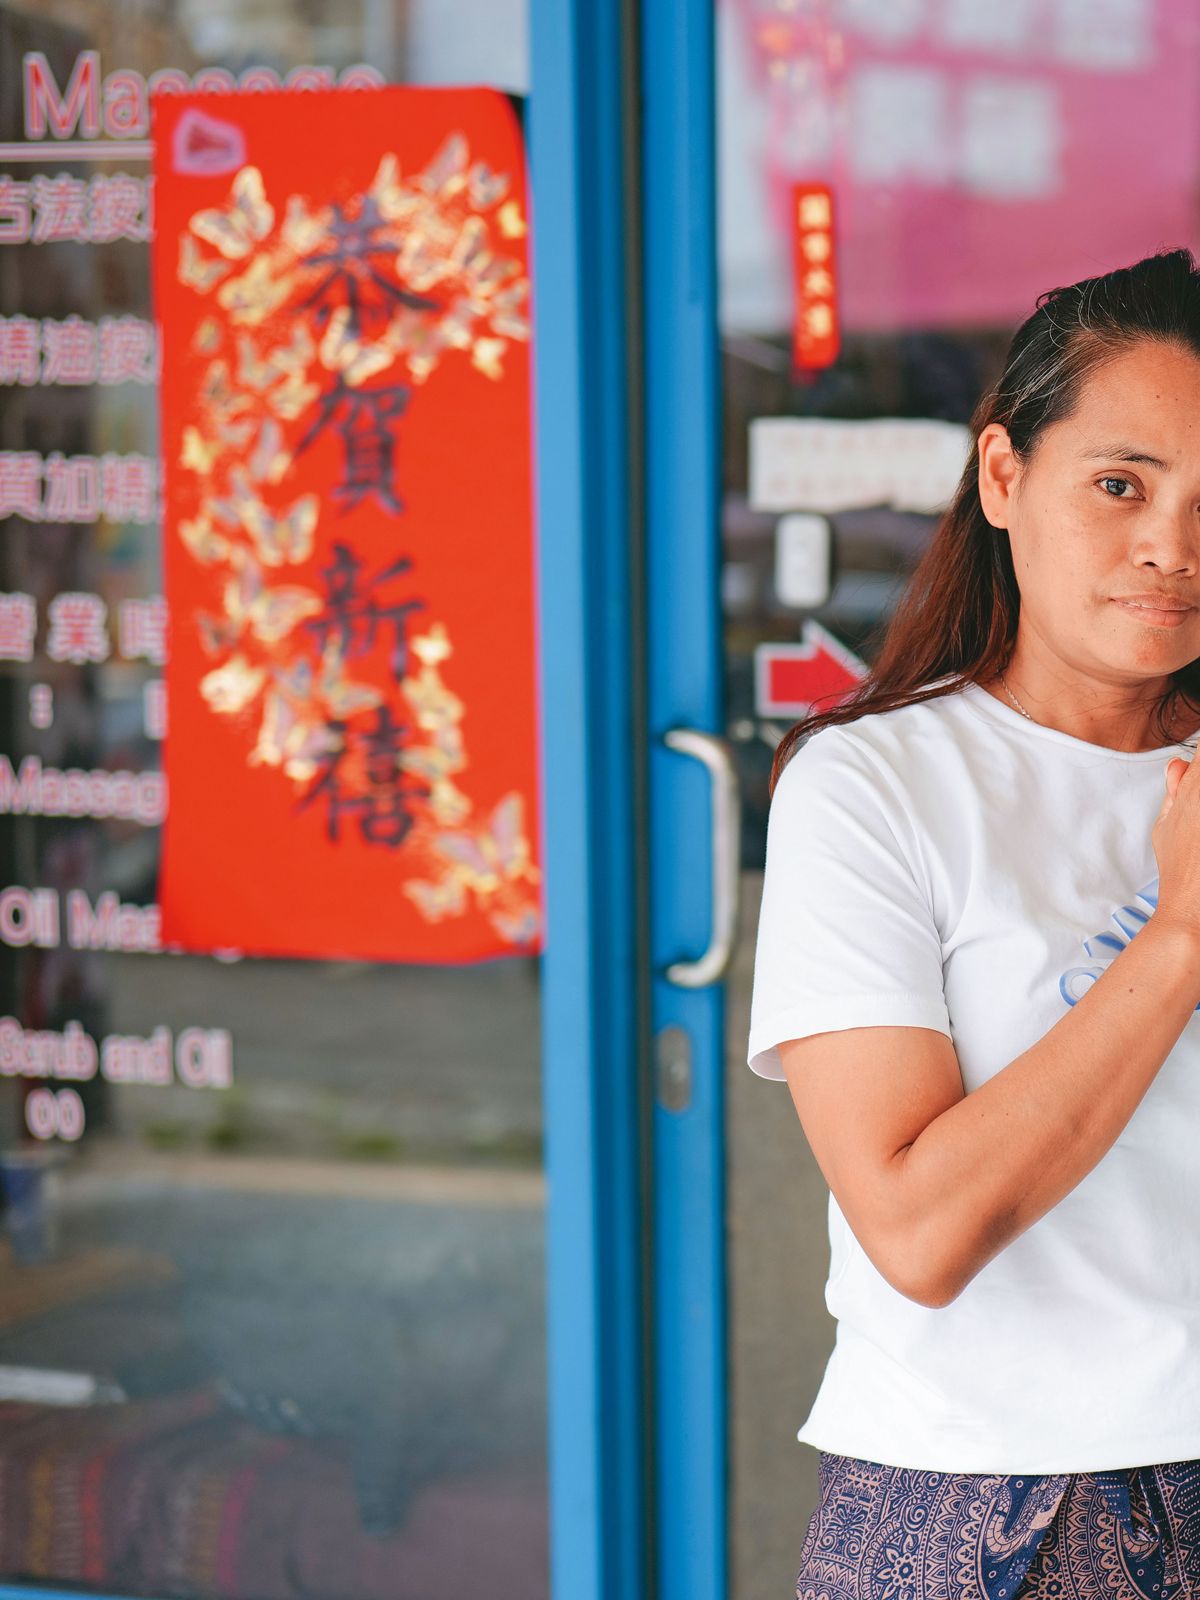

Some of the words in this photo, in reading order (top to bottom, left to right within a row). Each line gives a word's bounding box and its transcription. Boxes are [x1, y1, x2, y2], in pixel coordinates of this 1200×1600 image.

[0, 313, 162, 387] 精油按
[293, 196, 438, 848] 恭賀新禧
[0, 754, 168, 826] Massag
[0, 885, 60, 948] Oil
[101, 1025, 173, 1086] and
[176, 1026, 233, 1090] Oil
